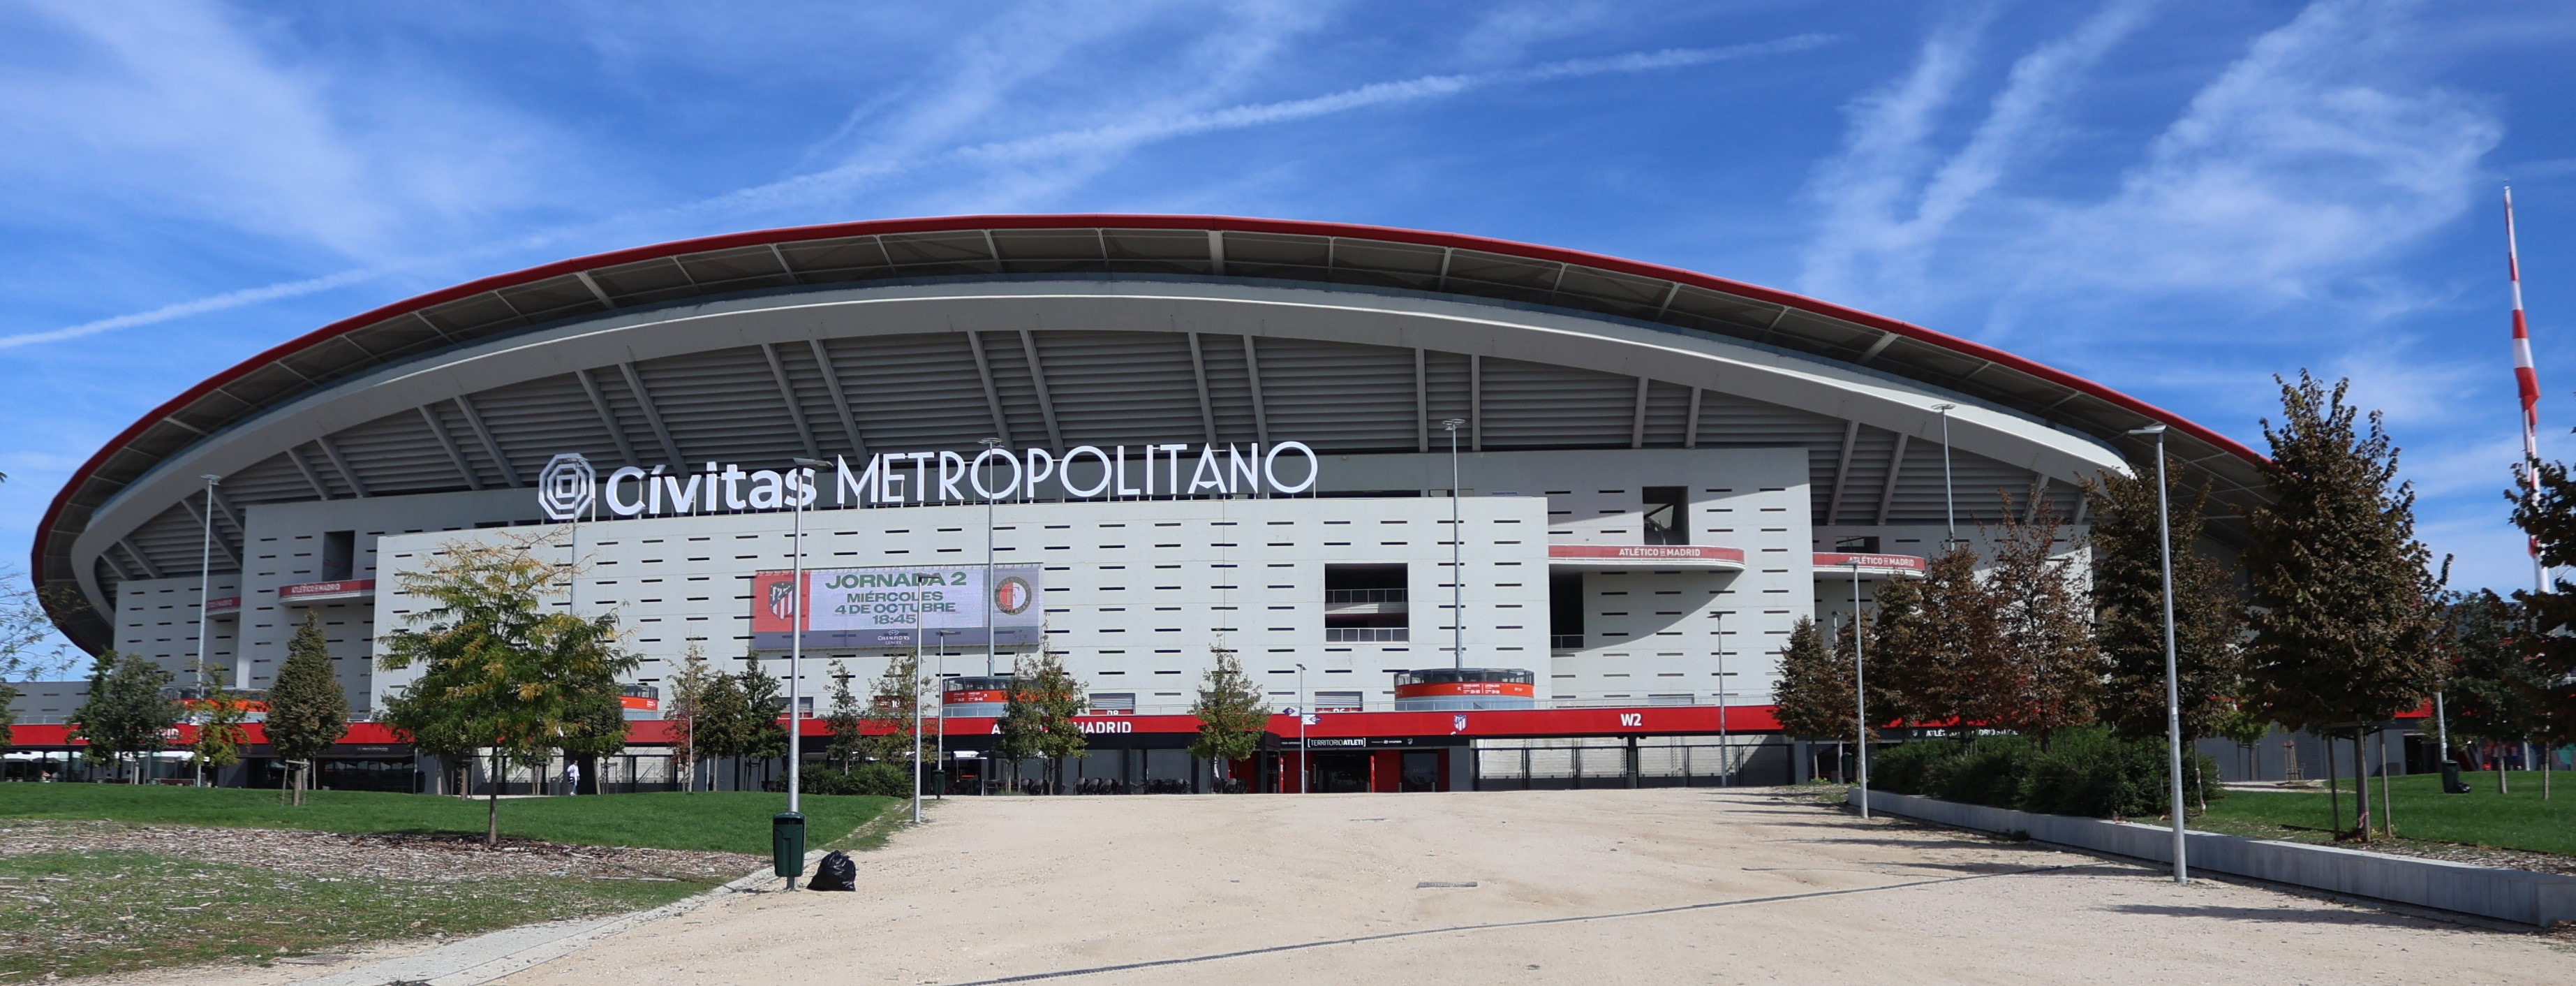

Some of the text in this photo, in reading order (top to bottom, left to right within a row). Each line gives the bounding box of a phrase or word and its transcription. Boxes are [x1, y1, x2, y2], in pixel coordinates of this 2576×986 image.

[605, 441, 1319, 515] Cívitas METROPOLITANO
[1619, 547, 1659, 556] ATLÉTICO
[1667, 548, 1701, 557] MADRID
[1889, 558, 1915, 566] MADRID
[825, 571, 967, 589] JORNADA 2
[847, 591, 944, 603] MIÉRCOLES
[834, 602, 956, 615] 4 DE OCTUBRE
[873, 614, 916, 624] 18:45
[1620, 713, 1642, 726] W2
